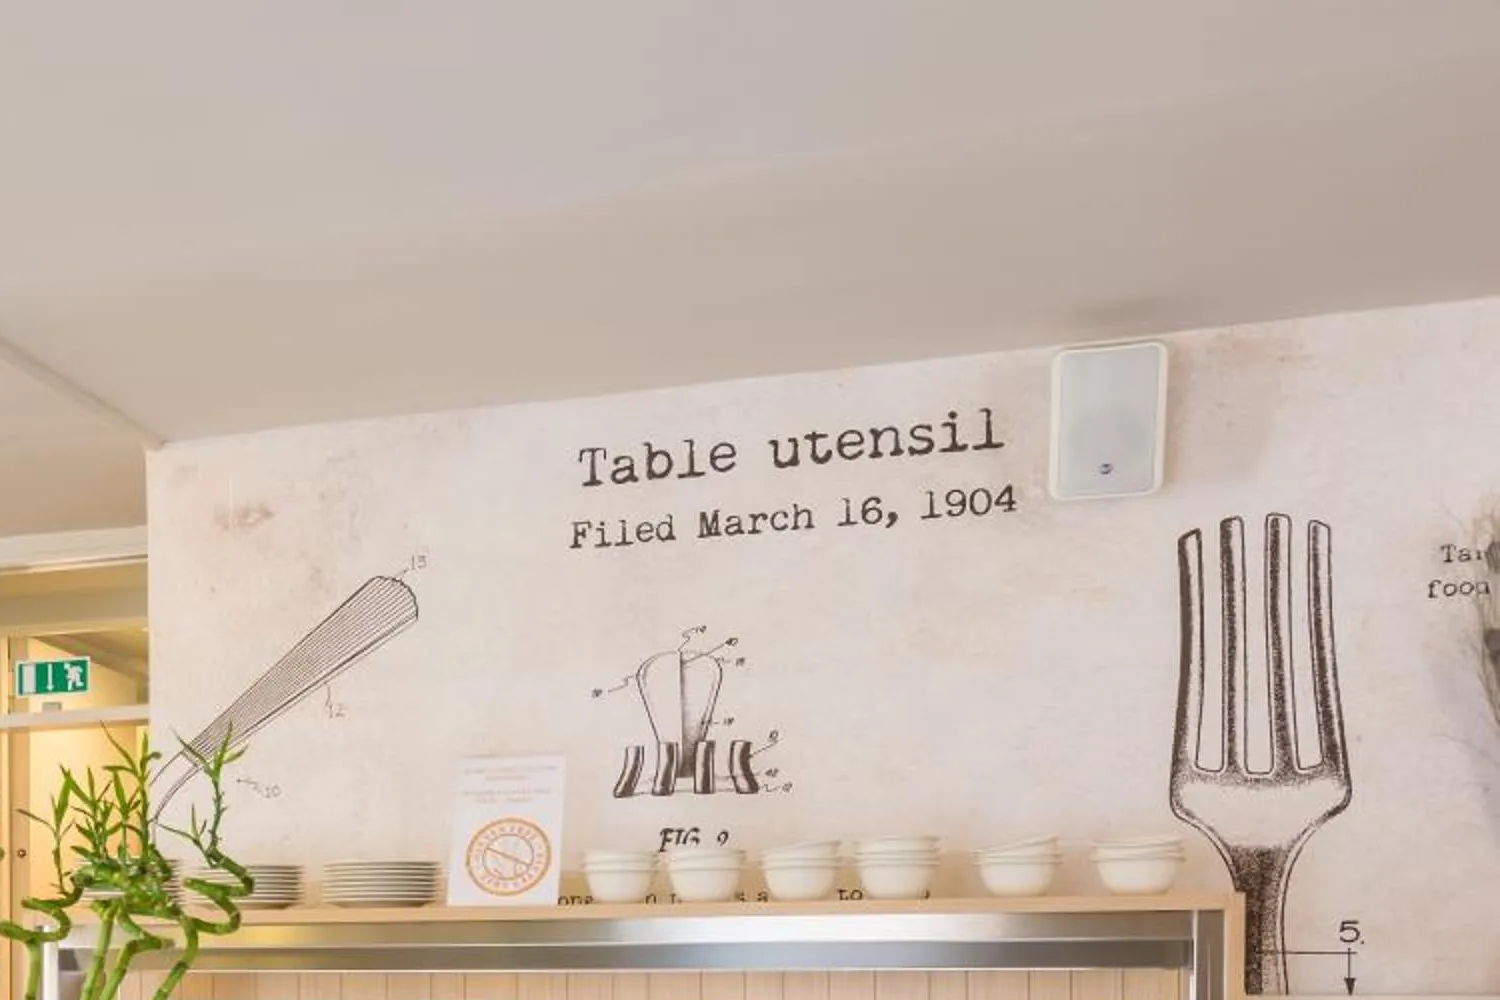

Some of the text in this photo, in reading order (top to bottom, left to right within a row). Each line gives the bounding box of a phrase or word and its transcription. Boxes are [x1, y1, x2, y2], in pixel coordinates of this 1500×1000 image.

[578, 407, 1006, 487] Table utensil
[569, 484, 1017, 549] Filed March 16, 1904
